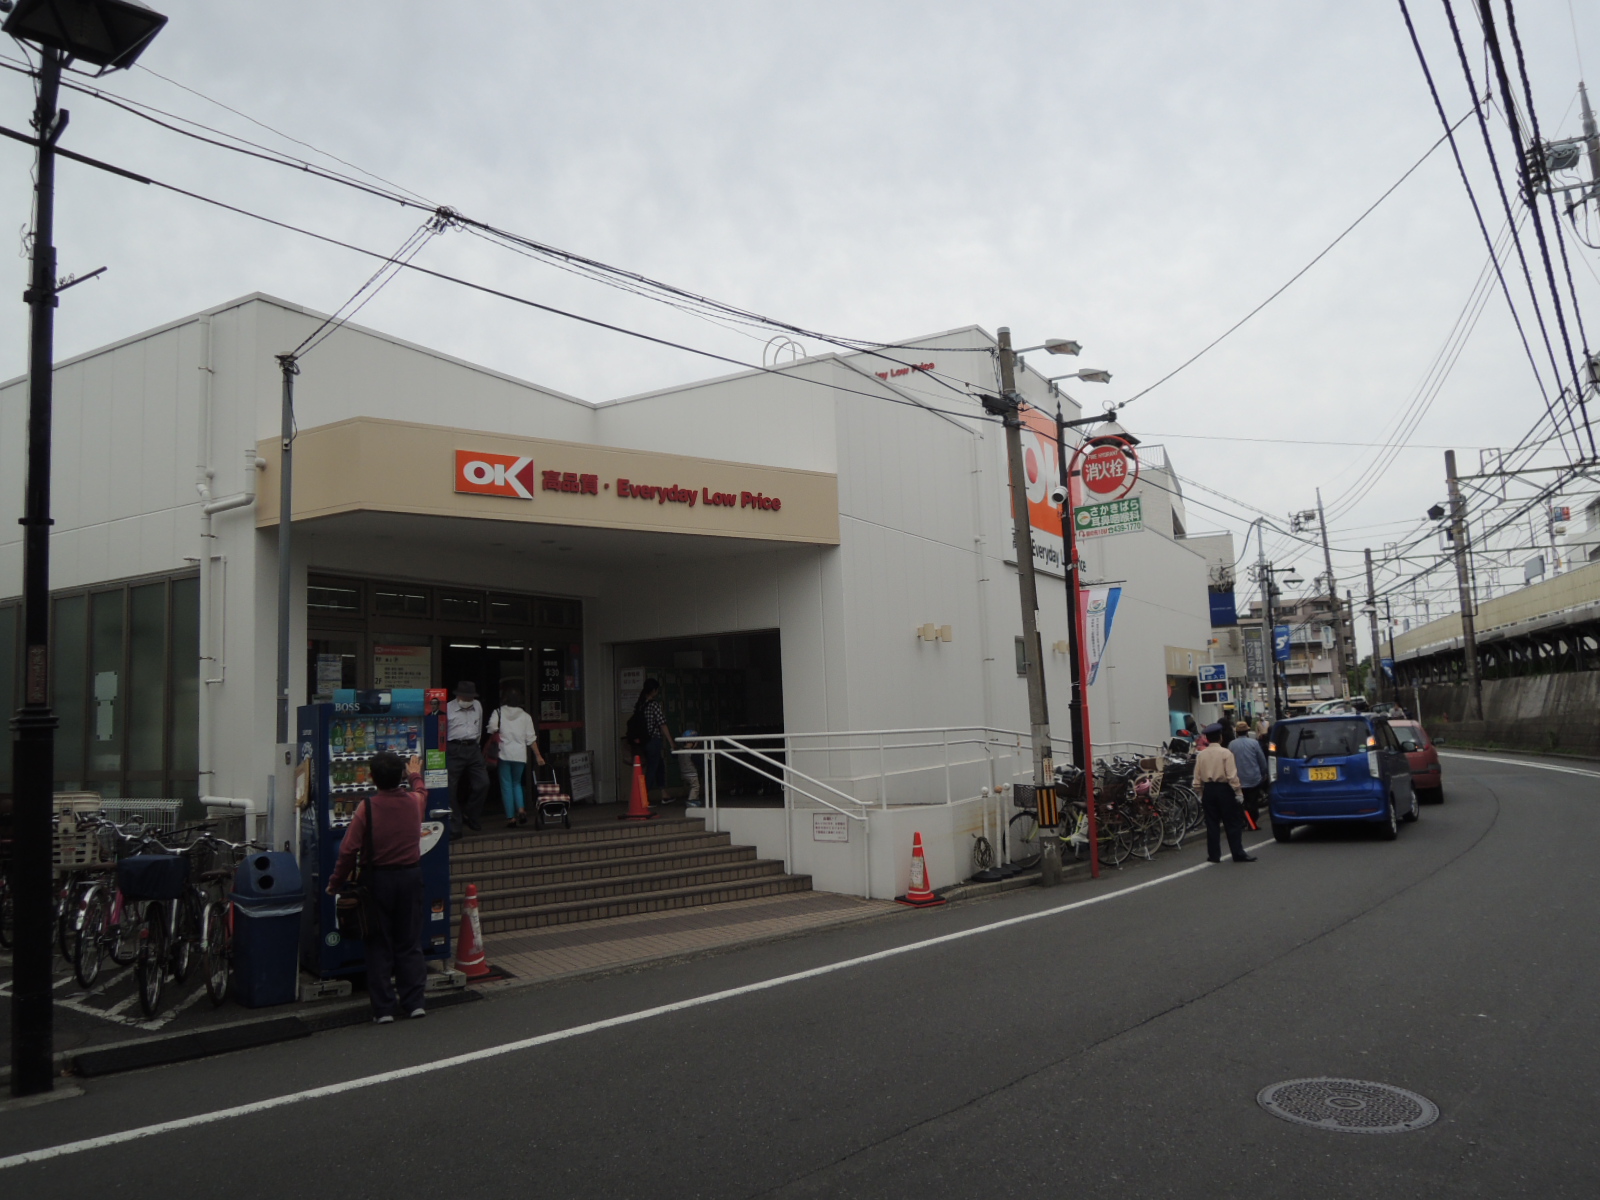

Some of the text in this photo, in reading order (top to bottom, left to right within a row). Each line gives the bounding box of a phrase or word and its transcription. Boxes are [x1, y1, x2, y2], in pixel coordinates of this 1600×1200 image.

[462, 456, 533, 499] OK
[1085, 459, 1124, 482] 消火栓
[616, 478, 698, 507] Everyday
[702, 487, 736, 507] Low
[740, 490, 781, 511] Price
[1089, 498, 1139, 517] さかきばら
[1091, 511, 1140, 527] 耳鼻咽喉科
[1031, 538, 1060, 568] Everyday
[545, 668, 560, 677] 8:30
[542, 683, 560, 692] 21:30
[335, 702, 360, 712] BOSS
